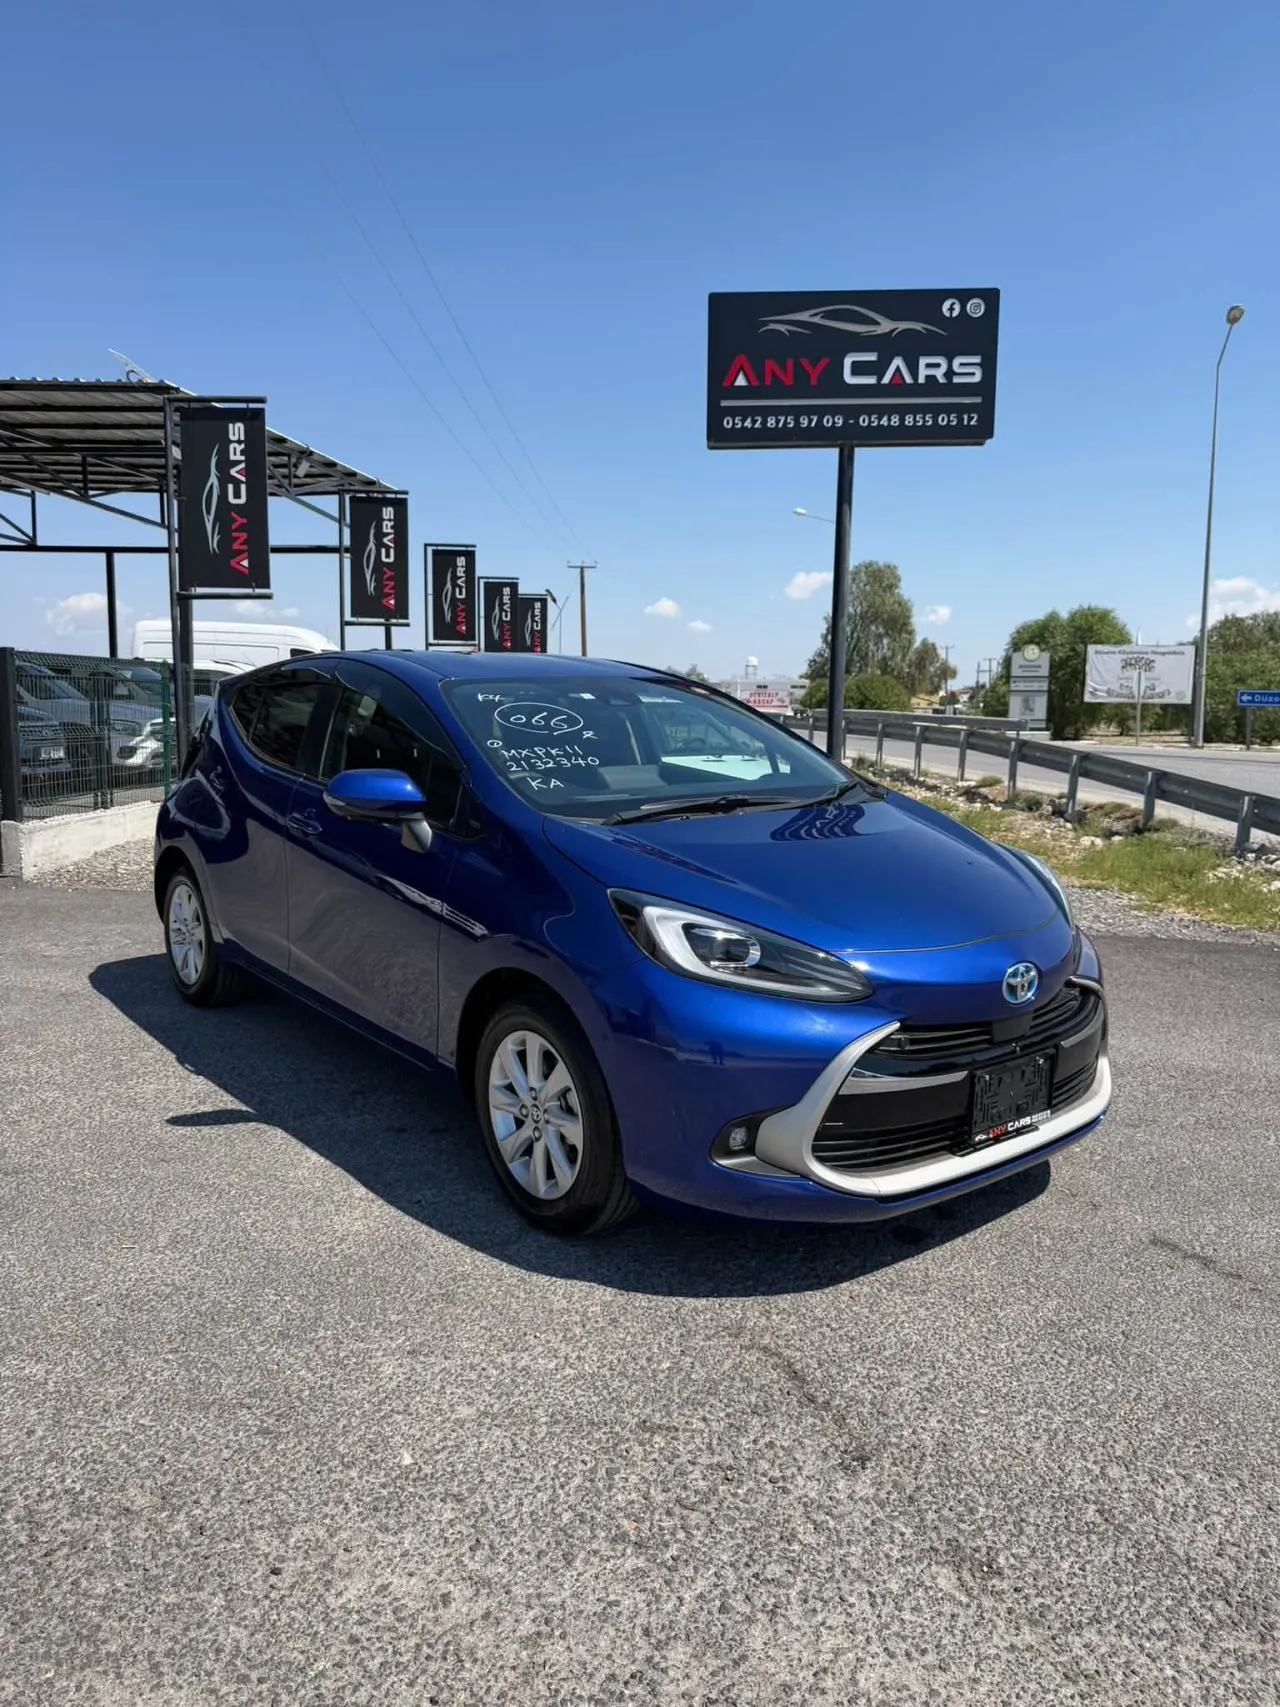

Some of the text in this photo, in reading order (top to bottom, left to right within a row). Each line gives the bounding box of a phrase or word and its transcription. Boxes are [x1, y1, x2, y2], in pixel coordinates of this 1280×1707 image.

[722, 352, 983, 387] ANY CARS
[723, 416, 762, 429] 0542
[767, 415, 795, 428] 875
[799, 415, 818, 428] 97
[823, 415, 844, 427] 09
[859, 414, 900, 427] 0548
[904, 414, 933, 427] 855
[938, 413, 957, 426] 05
[962, 413, 979, 426] 12
[227, 422, 249, 574] ANY CARS
[381, 506, 396, 610] ANY CARS
[455, 556, 466, 634] ANY CARS
[502, 586, 512, 649] ANY CARS
[533, 601, 542, 630] CARS
[510, 712, 568, 729] 066
[506, 757, 600, 772] 2132340
[527, 777, 564, 791] KA
[987, 1116, 1032, 1138] ANY CARS
